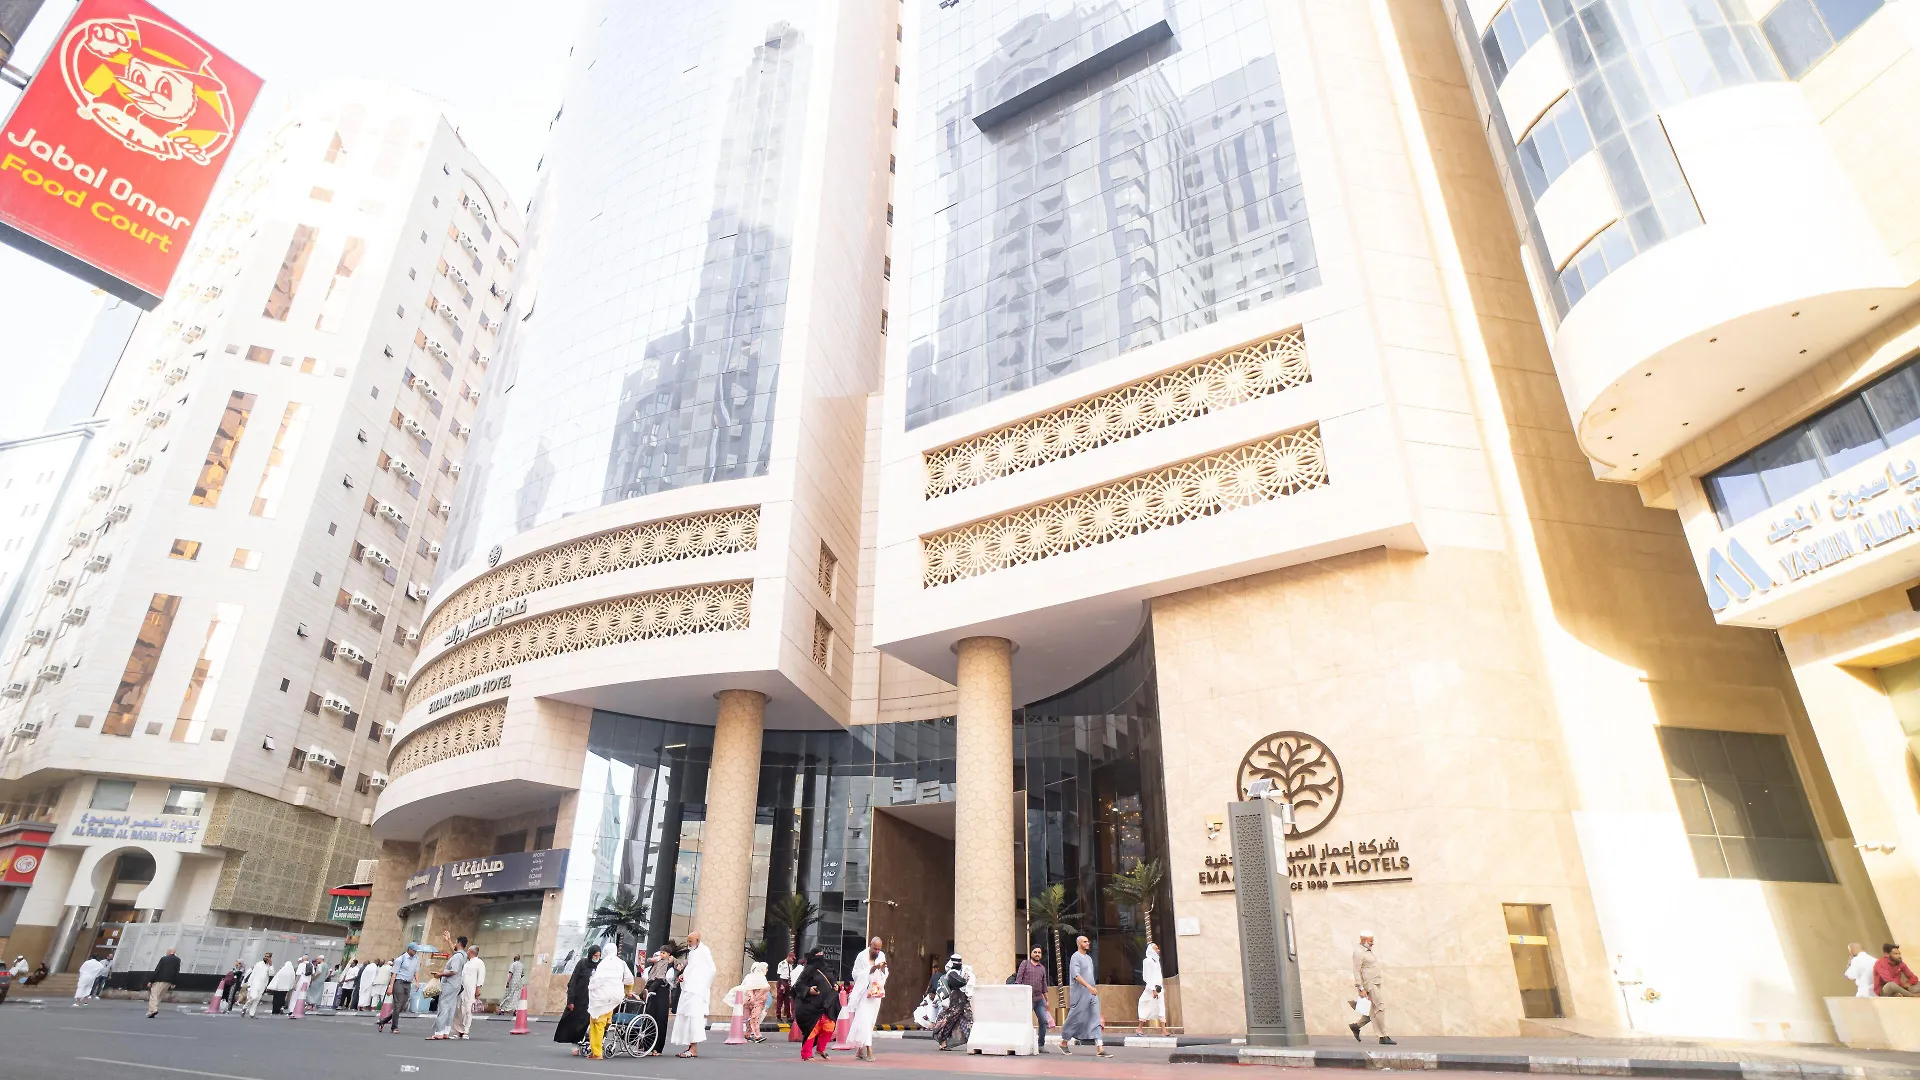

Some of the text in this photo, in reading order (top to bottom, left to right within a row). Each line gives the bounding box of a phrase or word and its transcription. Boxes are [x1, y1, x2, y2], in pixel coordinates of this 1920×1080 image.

[8, 128, 108, 188] Jabal
[109, 177, 191, 230] Omar
[1, 154, 87, 208] Food
[91, 202, 173, 253] Court
[1780, 529, 1854, 580] YASMIN
[453, 684, 481, 704] GRAND
[482, 674, 512, 695] HOTEL
[72, 826, 85, 837] AL
[116, 829, 129, 839] AL
[159, 831, 187, 843] HOTEL
[1358, 837, 1399, 855] شركة
[1320, 841, 1355, 860] إعمار
[1199, 870, 1234, 885] EMA
[1346, 856, 1410, 874] HOTELS
[1307, 880, 1328, 891] 1998
